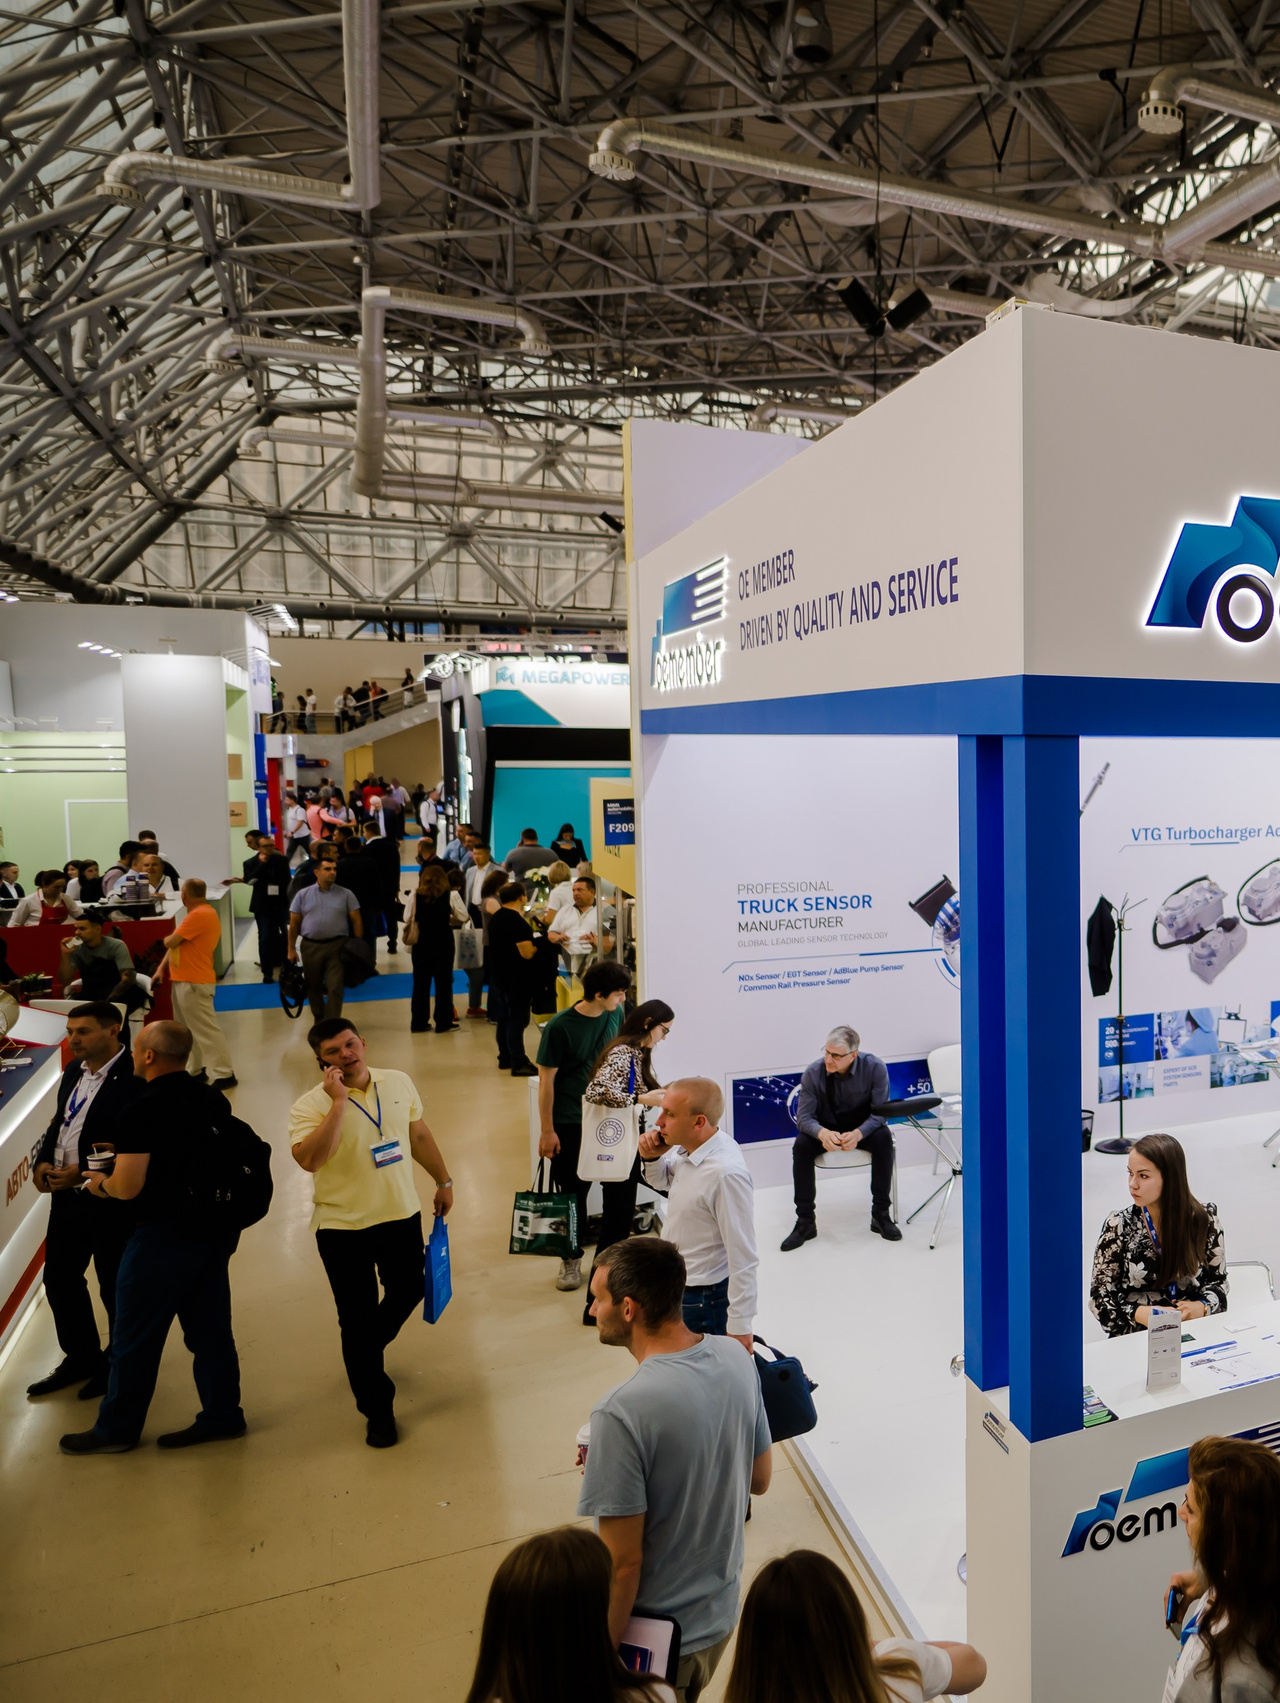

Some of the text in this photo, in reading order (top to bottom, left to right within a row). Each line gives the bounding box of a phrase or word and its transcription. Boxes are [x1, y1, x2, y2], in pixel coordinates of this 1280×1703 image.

[738, 548, 796, 601] OE MEMBER
[739, 556, 959, 651] DRIVEN BY QUALITY AND SERVICE
[521, 669, 630, 686] MEGAPOWER
[609, 823, 635, 833] F209
[1131, 827, 1162, 842] VTG
[1165, 825, 1263, 842] Turbocharger
[737, 880, 834, 895] PROFESSIONAL
[737, 894, 873, 915] TRUCK SENSOR
[737, 915, 844, 933] MANUFACTURER
[737, 931, 889, 948] GLOBAL LEADING SENSOR TECHNOLOGY
[755, 972, 781, 981] Sensor
[787, 970, 802, 979] EGT
[802, 968, 828, 977] Sensor
[833, 965, 859, 975] AdBlue
[859, 964, 880, 974] Pump
[880, 963, 904, 972] Sensor
[743, 982, 777, 992] Common
[777, 981, 792, 990] Rail
[792, 979, 826, 989] Pressure
[826, 977, 851, 986] Sensor
